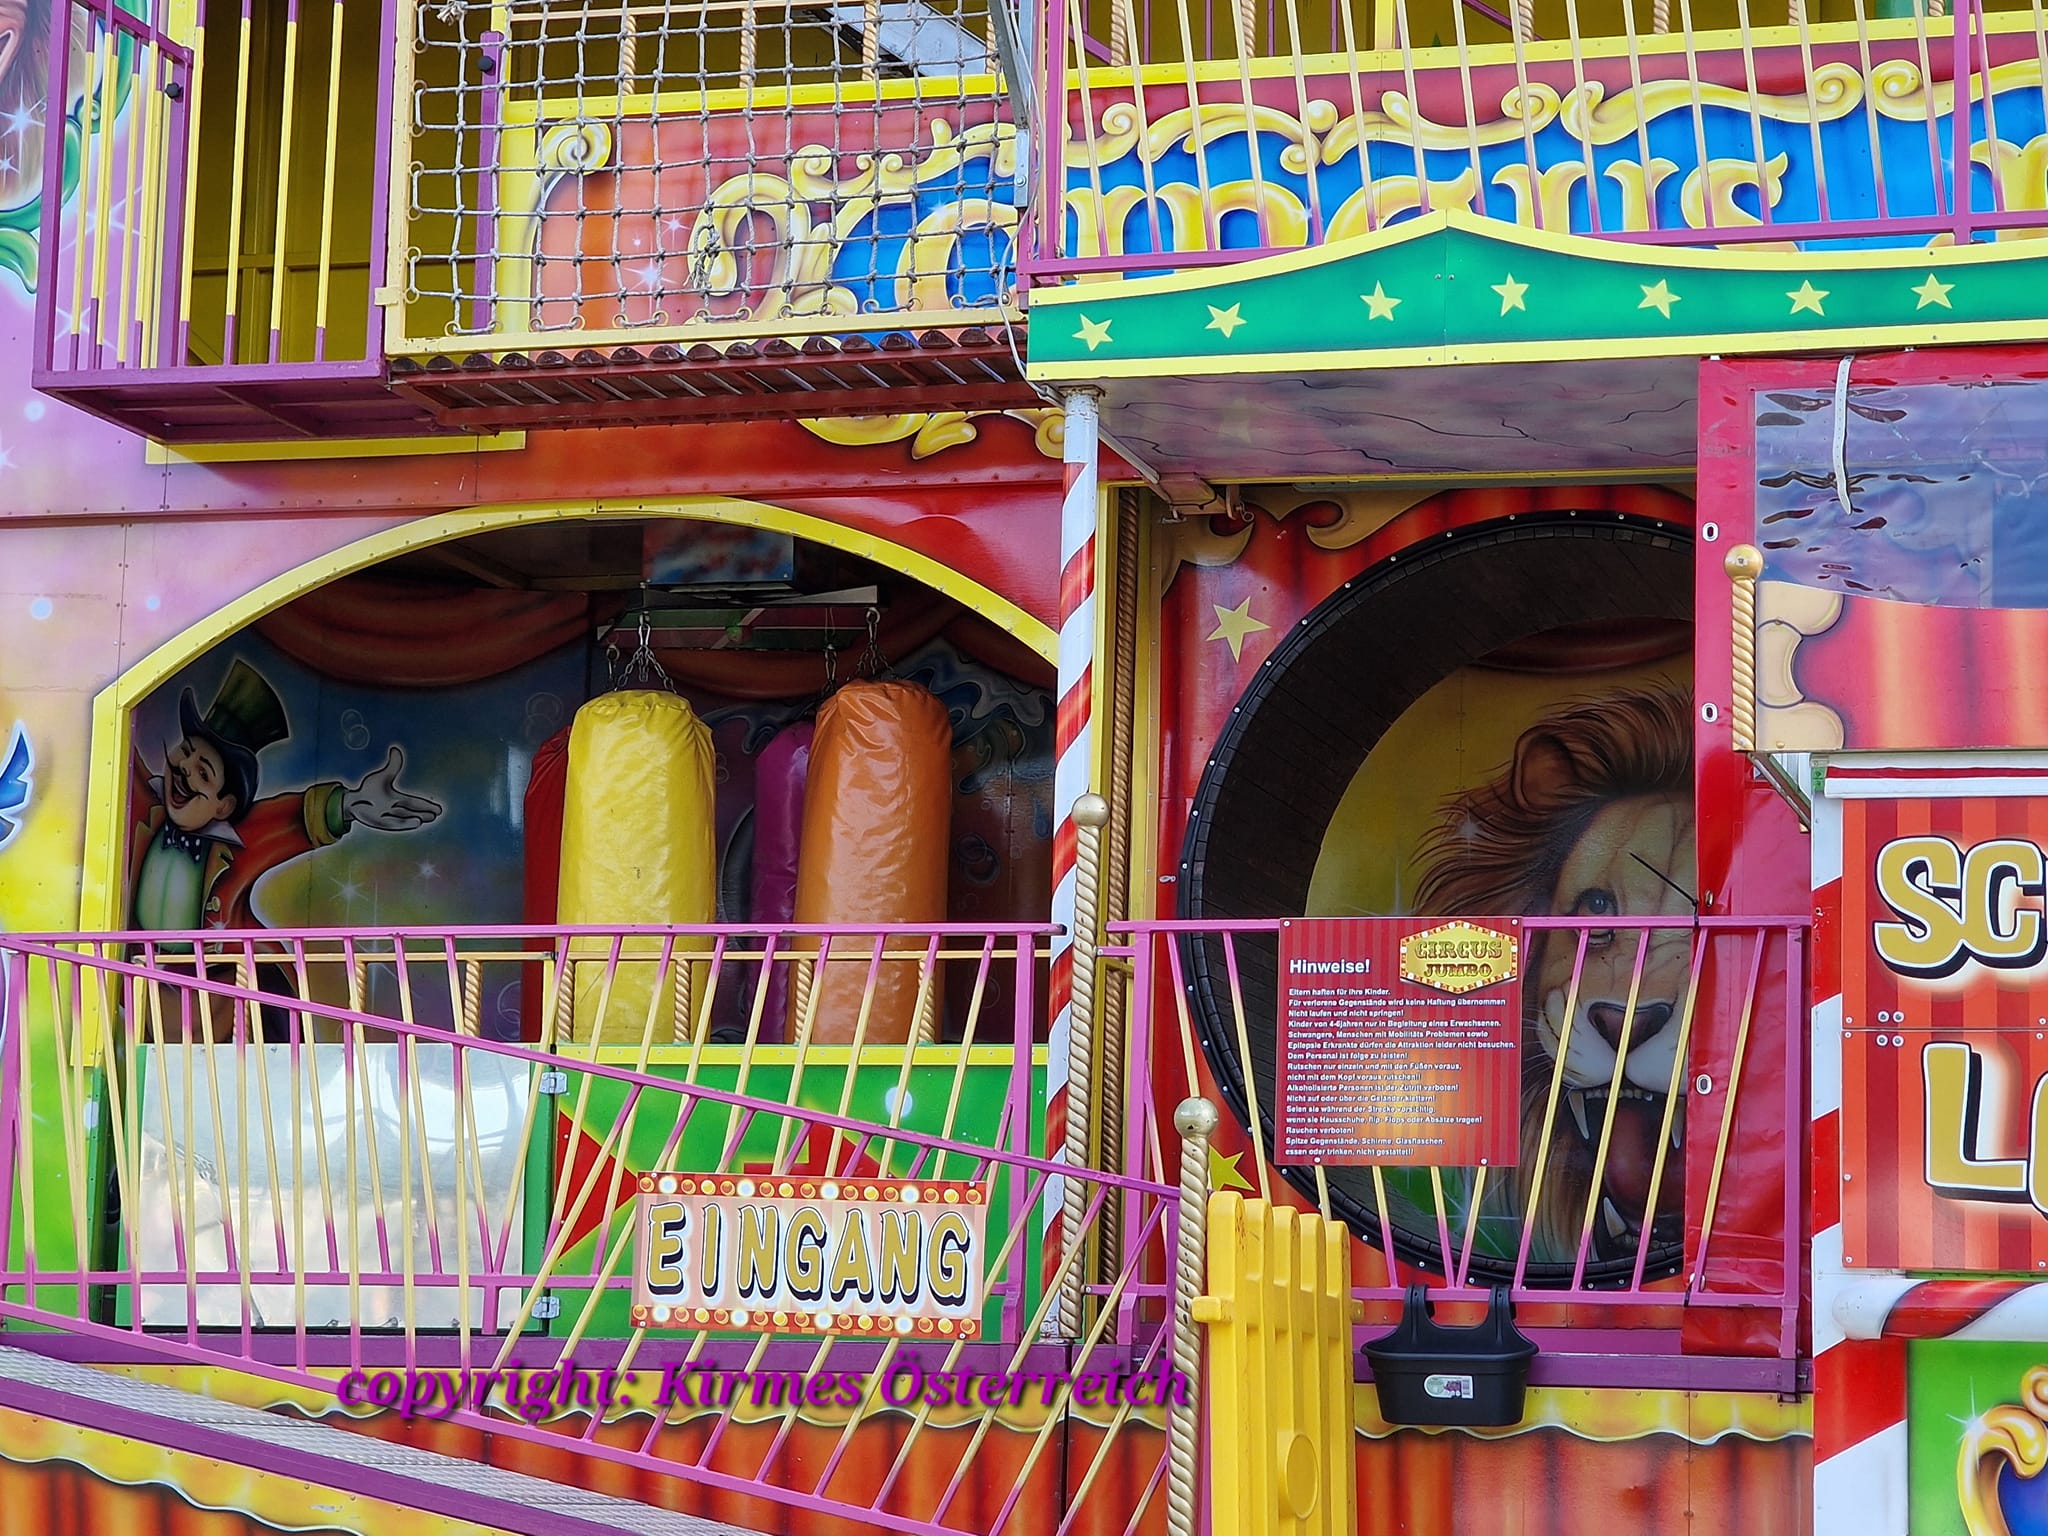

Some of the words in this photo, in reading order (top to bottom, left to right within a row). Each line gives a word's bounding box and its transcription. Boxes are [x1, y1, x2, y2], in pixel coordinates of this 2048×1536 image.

[1414, 940, 1503, 959] CIRCUS
[1289, 958, 1370, 974] Hinweise!
[1423, 963, 1492, 978] JUMBO
[1289, 988, 1311, 996] Eltern
[1312, 988, 1335, 996] haften
[1336, 988, 1348, 996] für
[1289, 999, 1301, 1007] Für
[1303, 999, 1337, 1007] verlorene
[1339, 999, 1387, 1008] Gegenstände
[1388, 999, 1404, 1007] wird
[1406, 999, 1425, 1007] keine
[1427, 999, 1456, 1007] Haftung
[1457, 999, 1506, 1007] übernommen
[1369, 1010, 1404, 1018] springen!
[1387, 1020, 1427, 1028] Begleitung
[1288, 1041, 1321, 1049] Epilepsie
[1323, 1041, 1358, 1049] Erkrankte
[1359, 1041, 1383, 1049] dürfen
[1384, 1041, 1396, 1049] die
[1397, 1041, 1434, 1049] Attraktion
[1435, 1041, 1456, 1049] leider
[1457, 1041, 1476, 1049] nicht
[1287, 1073, 1306, 1081] nicht
[1307, 1073, 1319, 1081] mit
[1320, 1073, 1336, 1081] dem
[1337, 1073, 1356, 1081] Kopf
[1357, 1073, 1381, 1081] voraus
[1287, 1084, 1337, 1092] Alkoholisierte
[1339, 1084, 1373, 1092] Personen
[1375, 1084, 1384, 1092] ist
[1385, 1084, 1398, 1092] der
[1399, 1084, 1422, 1092] Zutritt
[1286, 1105, 1307, 1113] Seien
[1308, 1105, 1319, 1113] sie
[1321, 1105, 1352, 1113] während
[1353, 1105, 1366, 1113] der
[1285, 1137, 1309, 1145] Spitze
[1285, 1148, 1307, 1156] essen
[1308, 1148, 1325, 1156] oder
[1356, 1148, 1375, 1156] nicht
[647, 1201, 971, 1306] EINGANG
